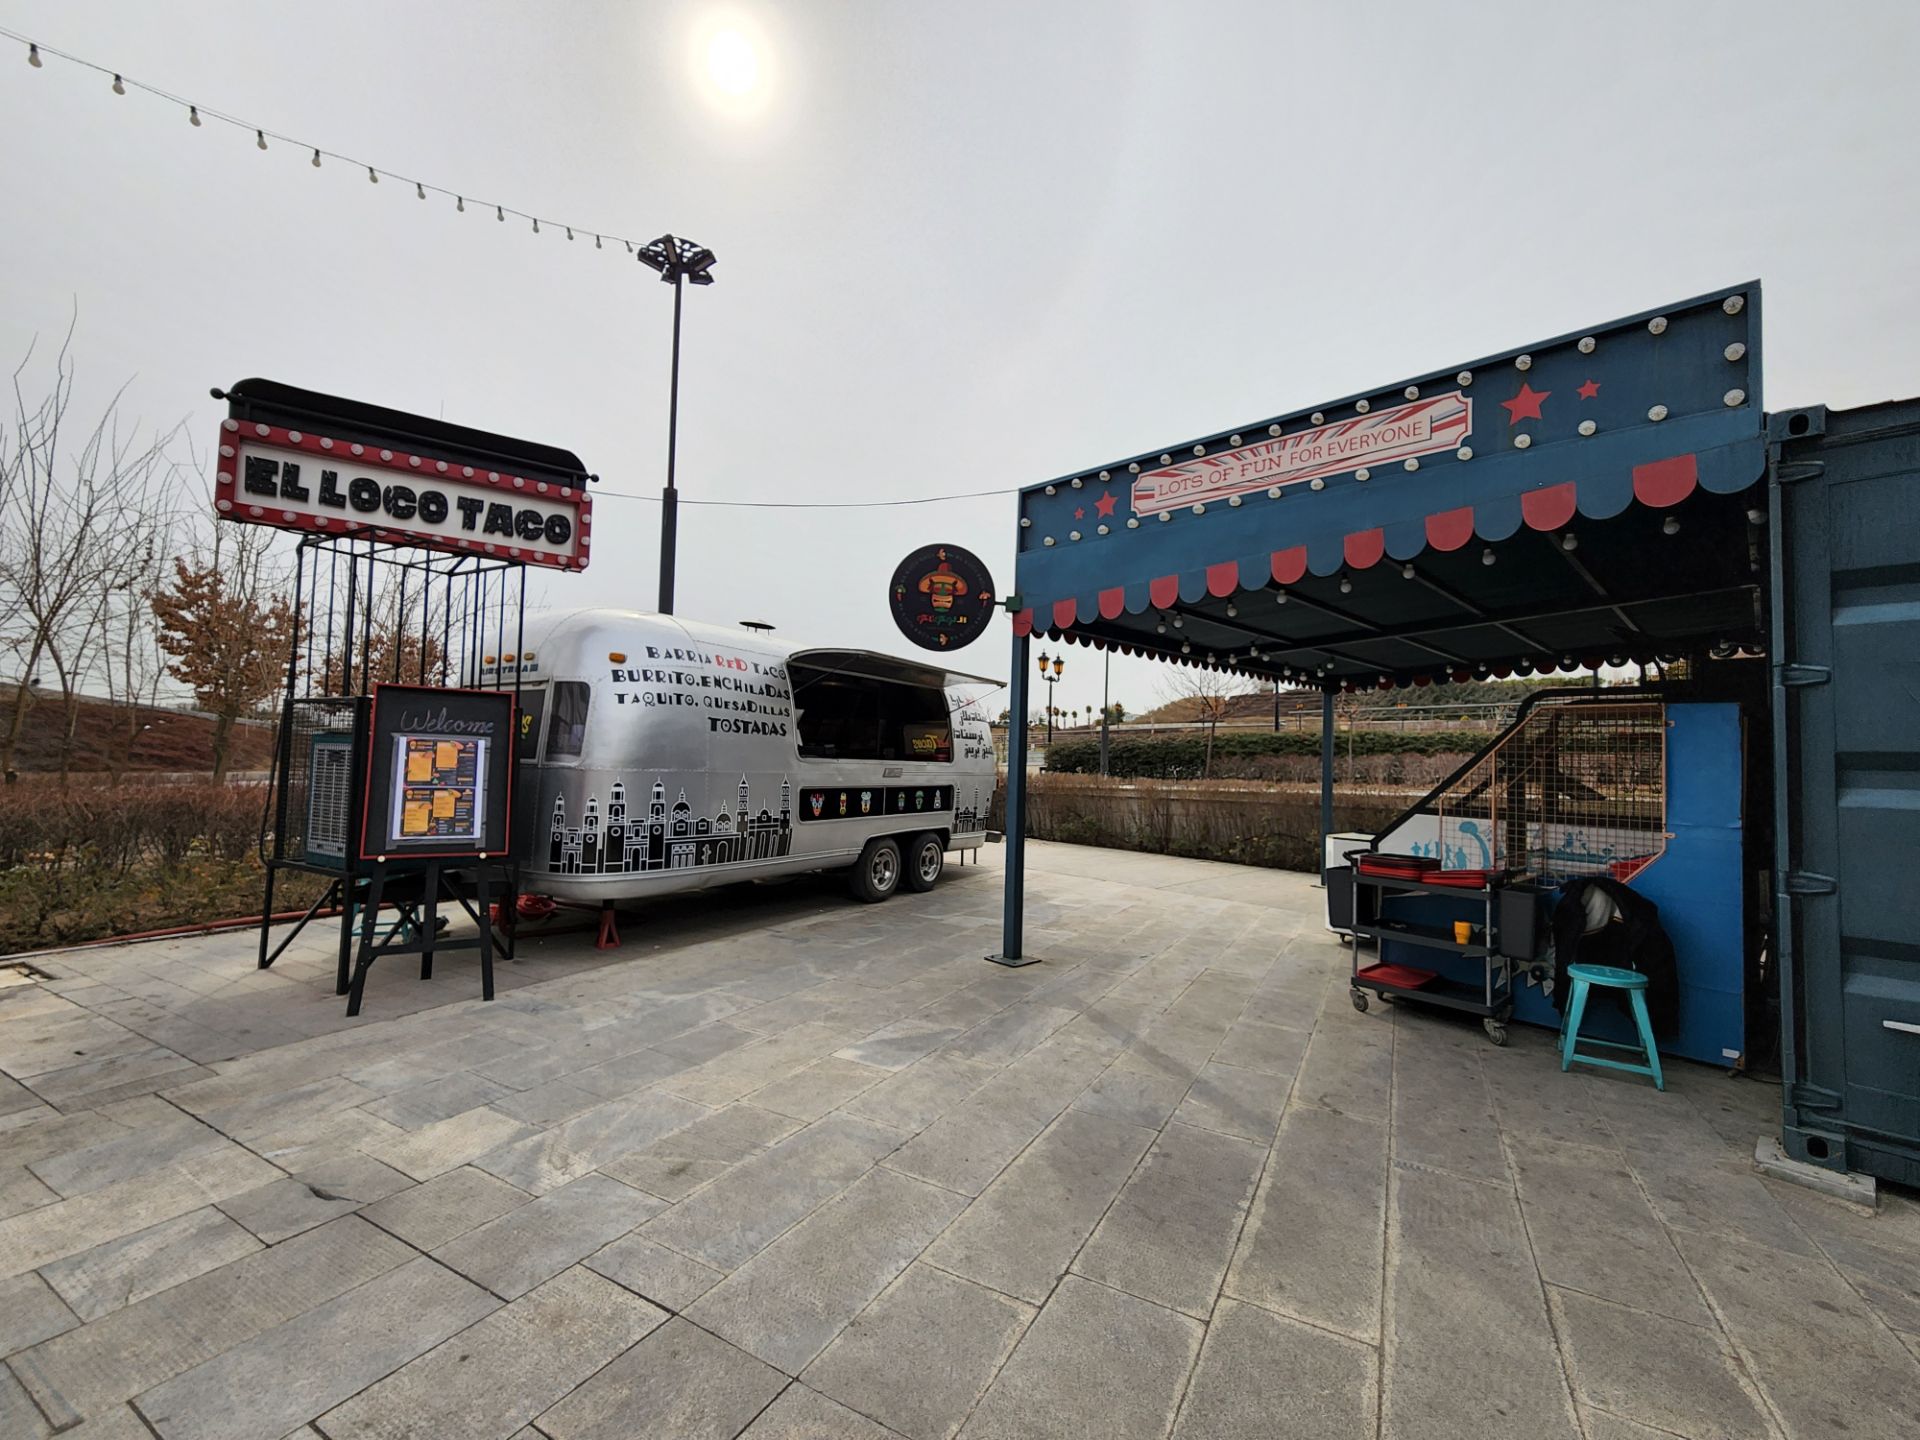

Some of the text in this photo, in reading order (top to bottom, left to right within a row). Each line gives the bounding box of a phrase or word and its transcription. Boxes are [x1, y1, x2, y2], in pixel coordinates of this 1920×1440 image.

[1158, 420, 1424, 497] LOTS OF FUN FOR EVERYONE
[244, 455, 572, 545] EL LOCO TACO
[645, 646, 712, 664] BARRIA
[751, 661, 787, 681] TACO
[400, 707, 495, 734] Welcome
[703, 695, 790, 718] QUESADILLAS
[708, 716, 787, 737] TOSTADAS
